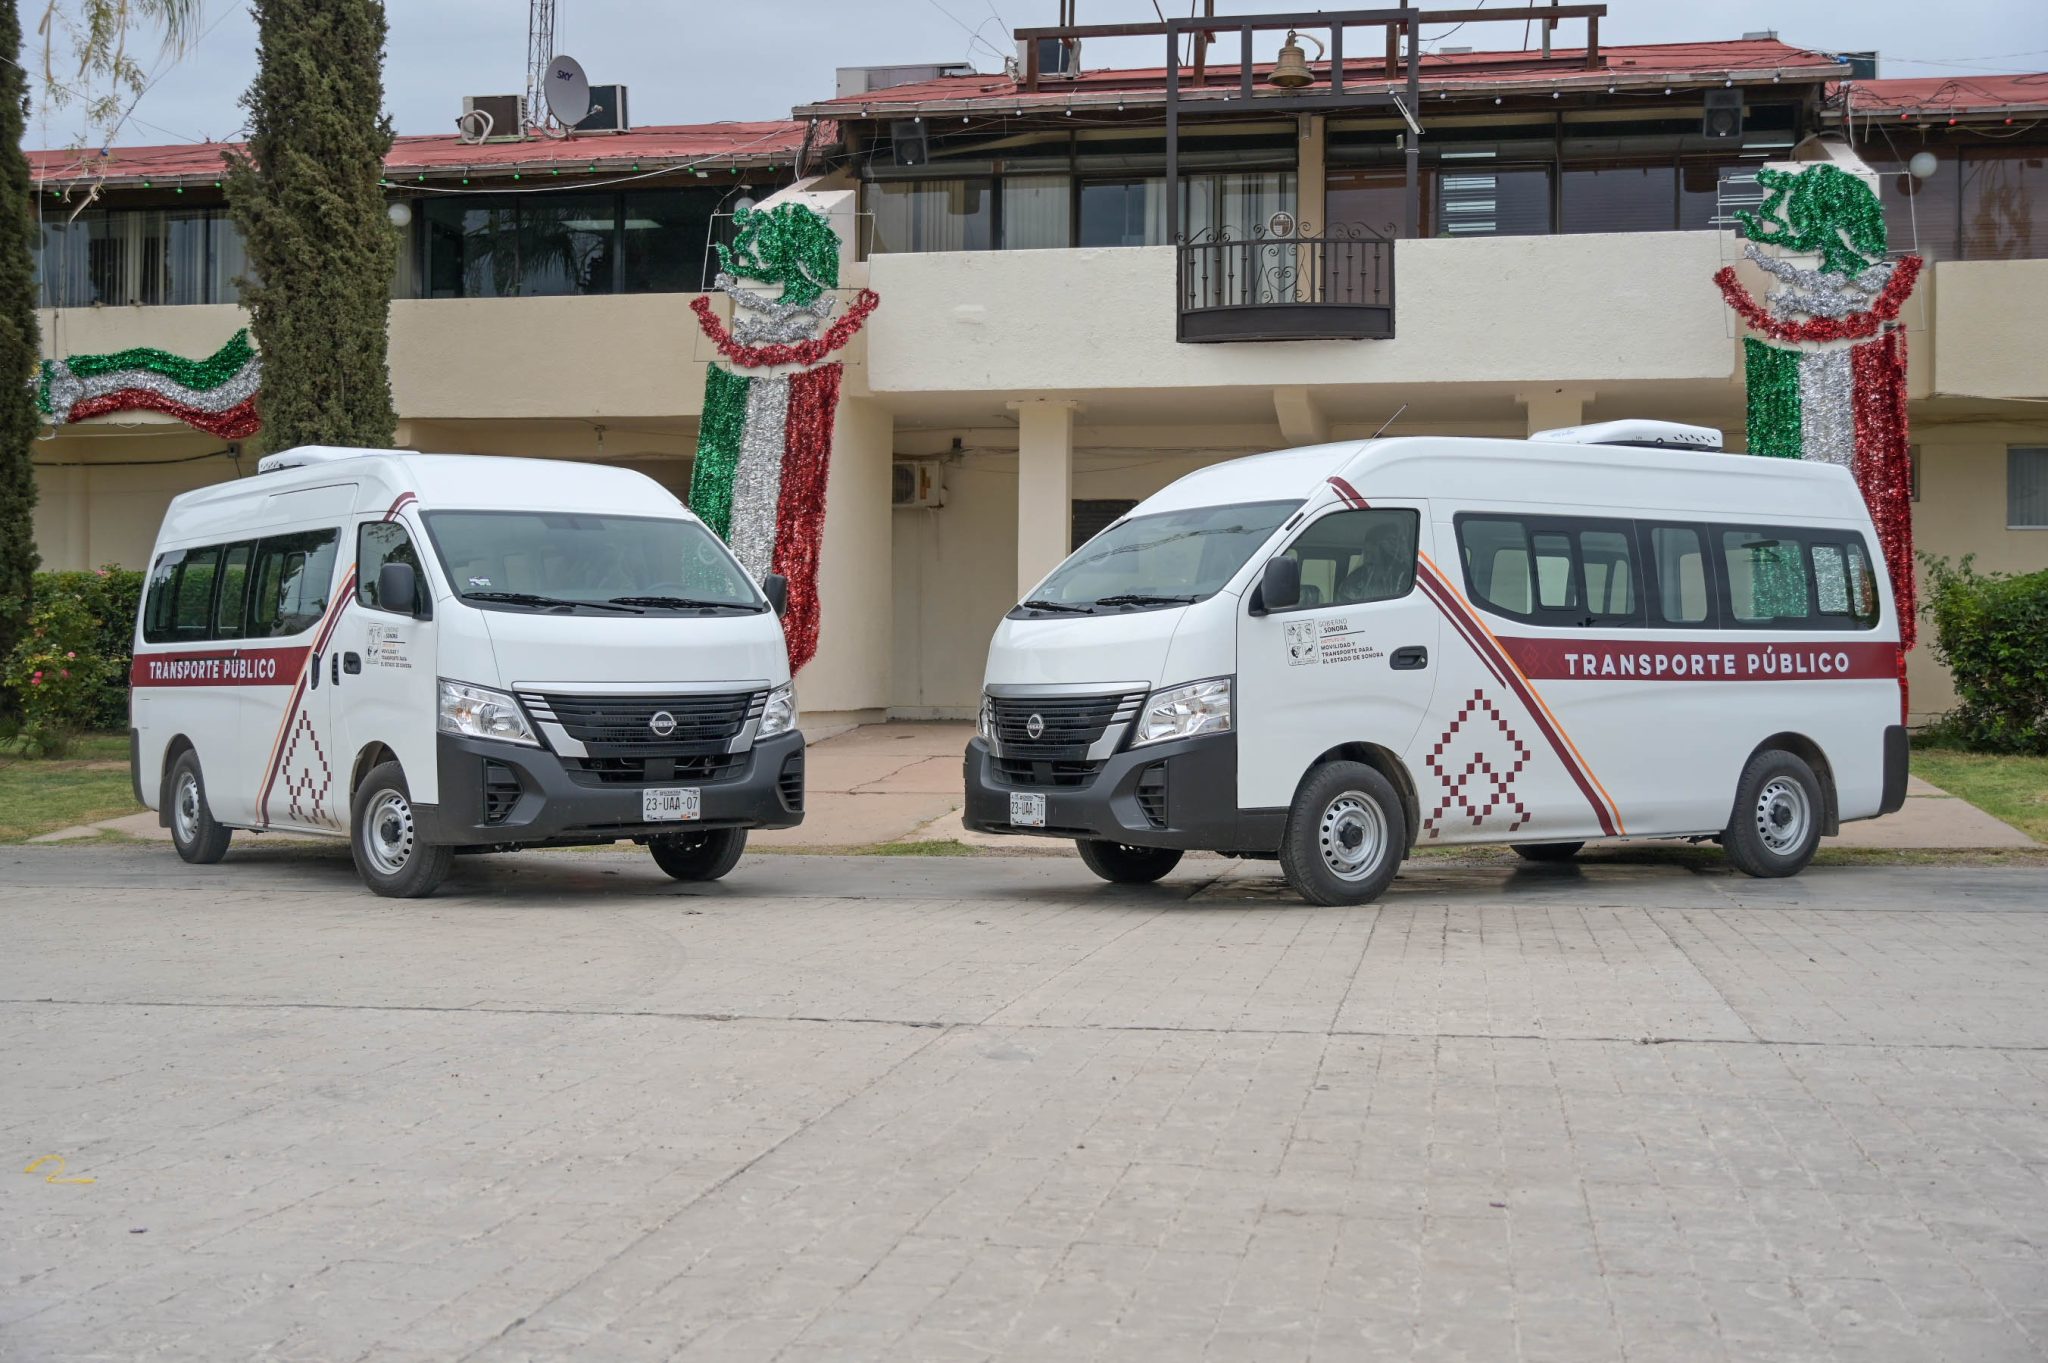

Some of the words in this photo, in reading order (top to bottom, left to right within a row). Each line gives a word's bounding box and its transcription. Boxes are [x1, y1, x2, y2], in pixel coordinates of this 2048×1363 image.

[556, 70, 573, 81] SKY
[1324, 625, 1348, 633] SONORA
[1322, 648, 1357, 657] TRANSPORTE
[150, 660, 219, 679] TRANSPORTE
[223, 649, 276, 679] PÚBLICO
[1564, 653, 1737, 676] TRANSPORTE
[1747, 645, 1850, 674] PÚBLICO
[645, 796, 698, 811] 23-UAA-07
